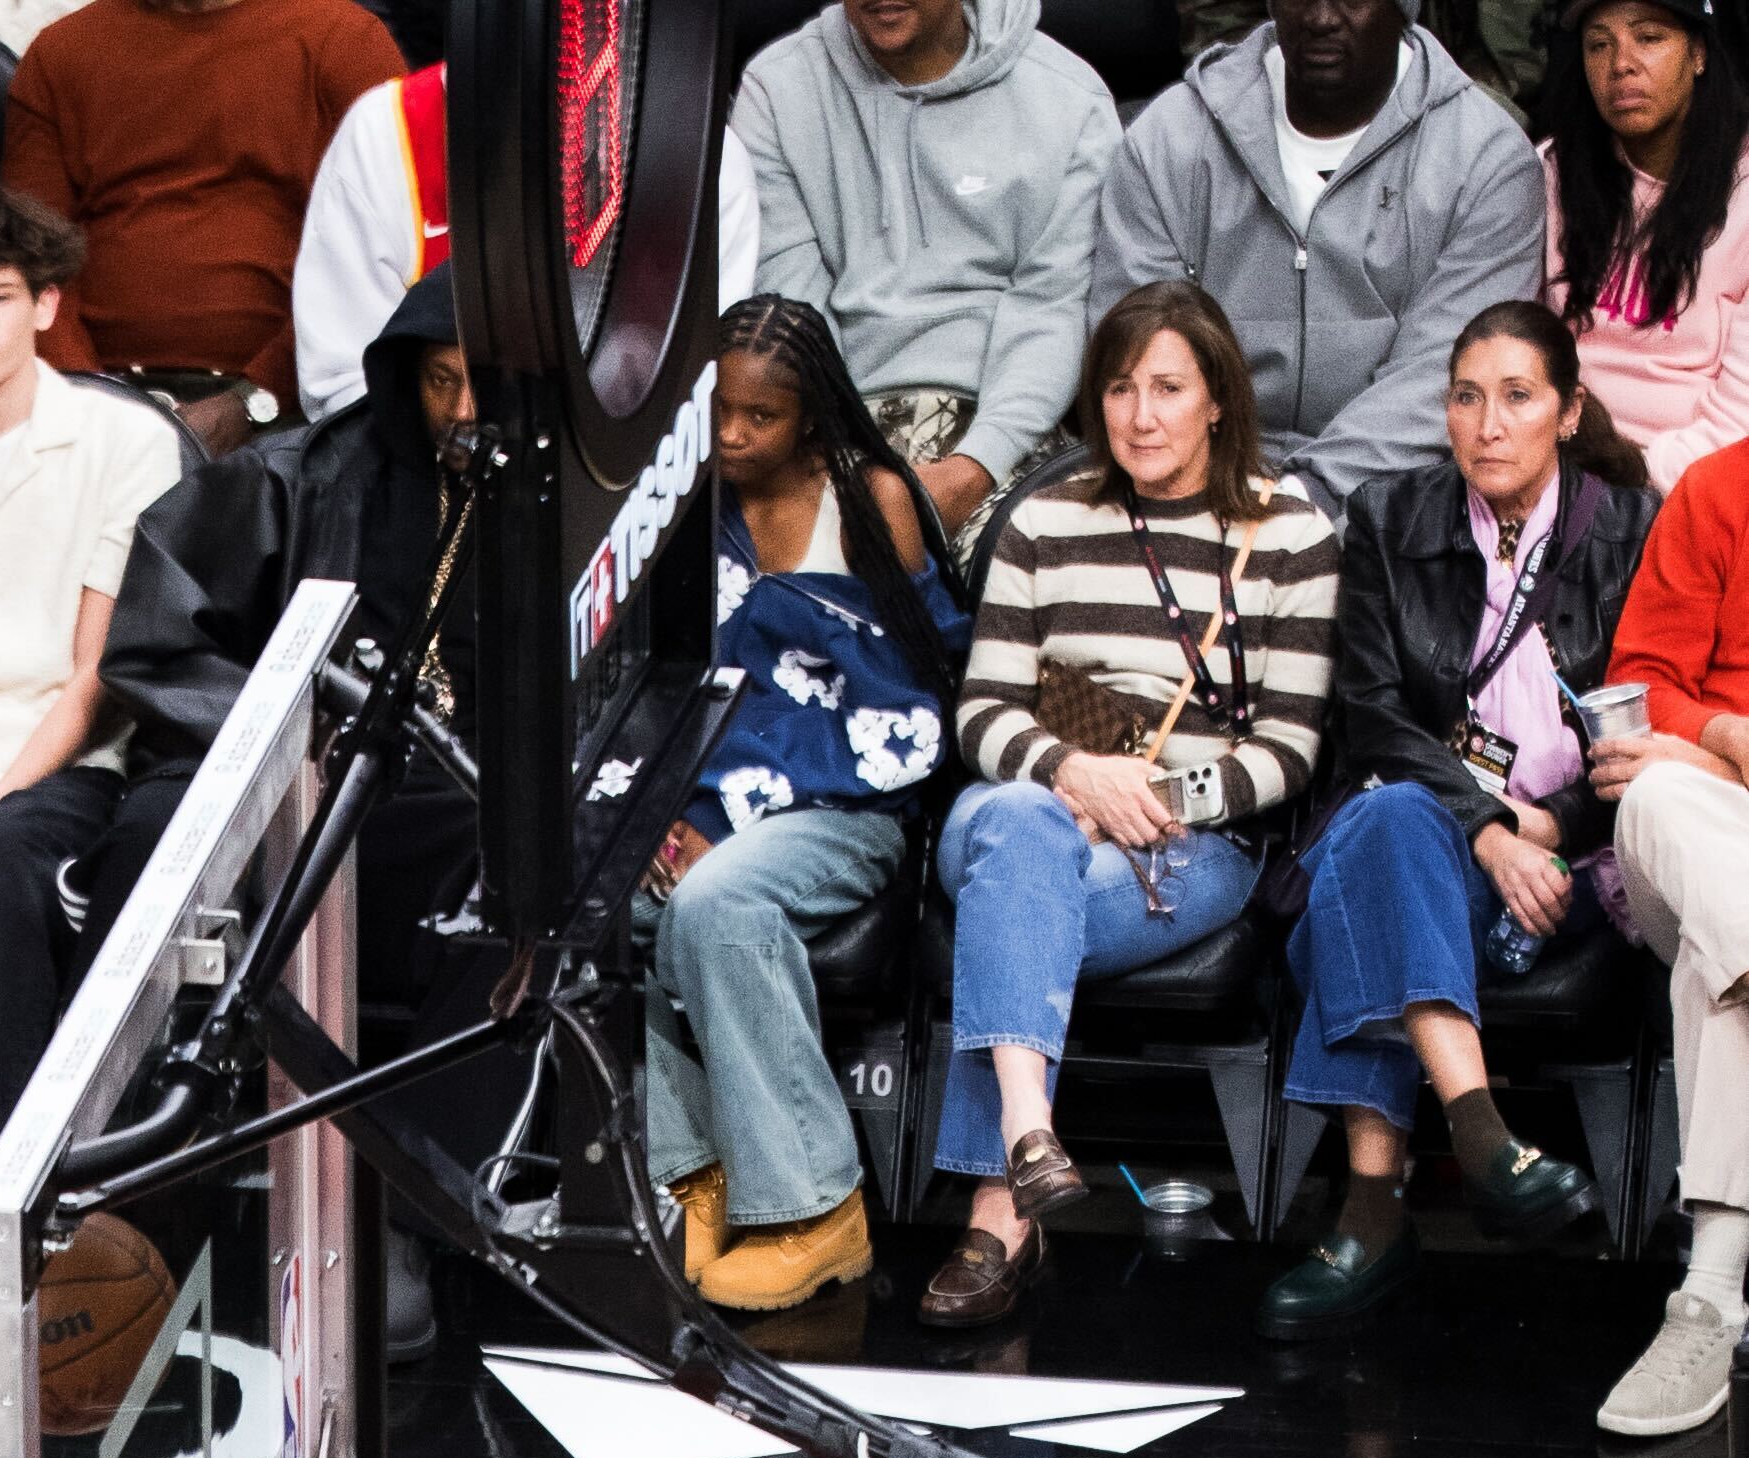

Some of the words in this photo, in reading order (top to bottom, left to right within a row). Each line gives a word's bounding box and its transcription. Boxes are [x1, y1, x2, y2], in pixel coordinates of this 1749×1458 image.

[611, 360, 717, 603] TISSOT
[1502, 593, 1527, 641] ATLANTA
[850, 1063, 893, 1097] 10
